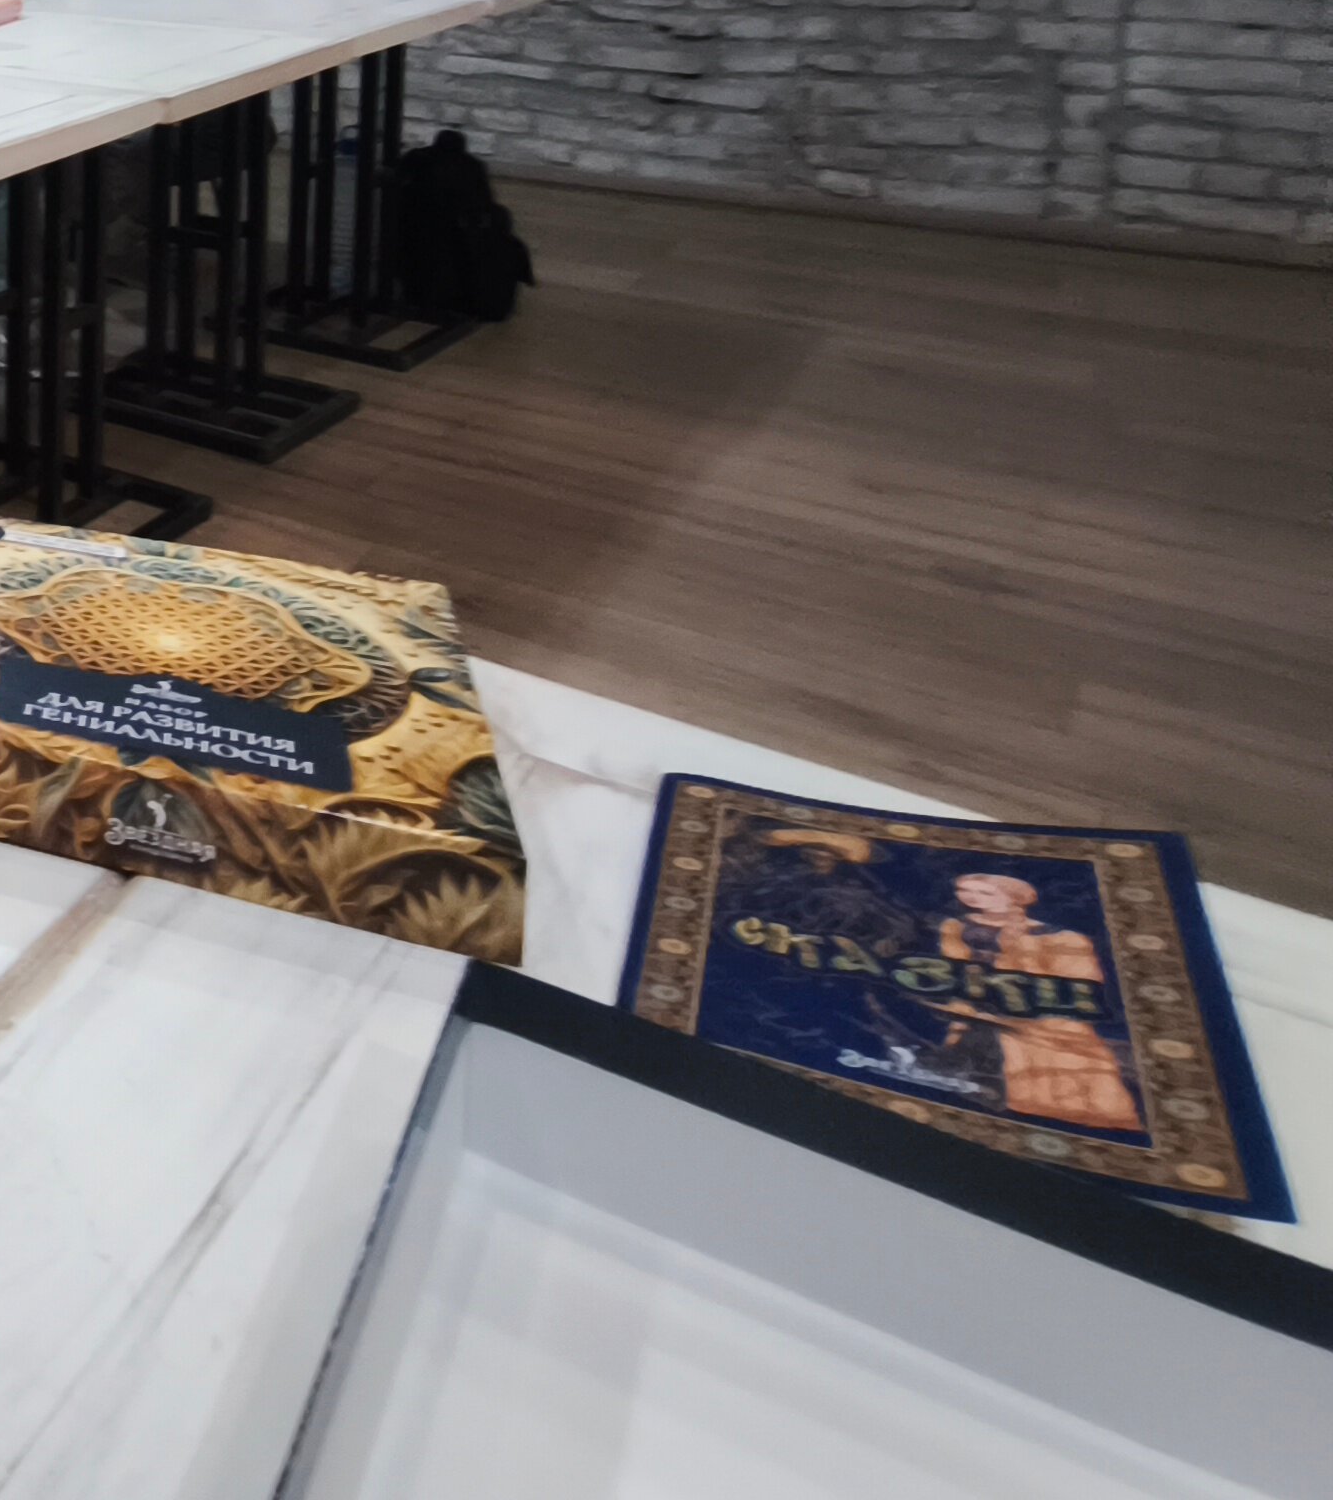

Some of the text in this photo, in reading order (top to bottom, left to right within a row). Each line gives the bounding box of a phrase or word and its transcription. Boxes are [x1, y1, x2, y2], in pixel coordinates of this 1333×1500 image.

[22, 703, 316, 775] ГЕНИАЛЬНОСТИ
[36, 692, 297, 754] ДЛЯ РАЗВИТИЯ
